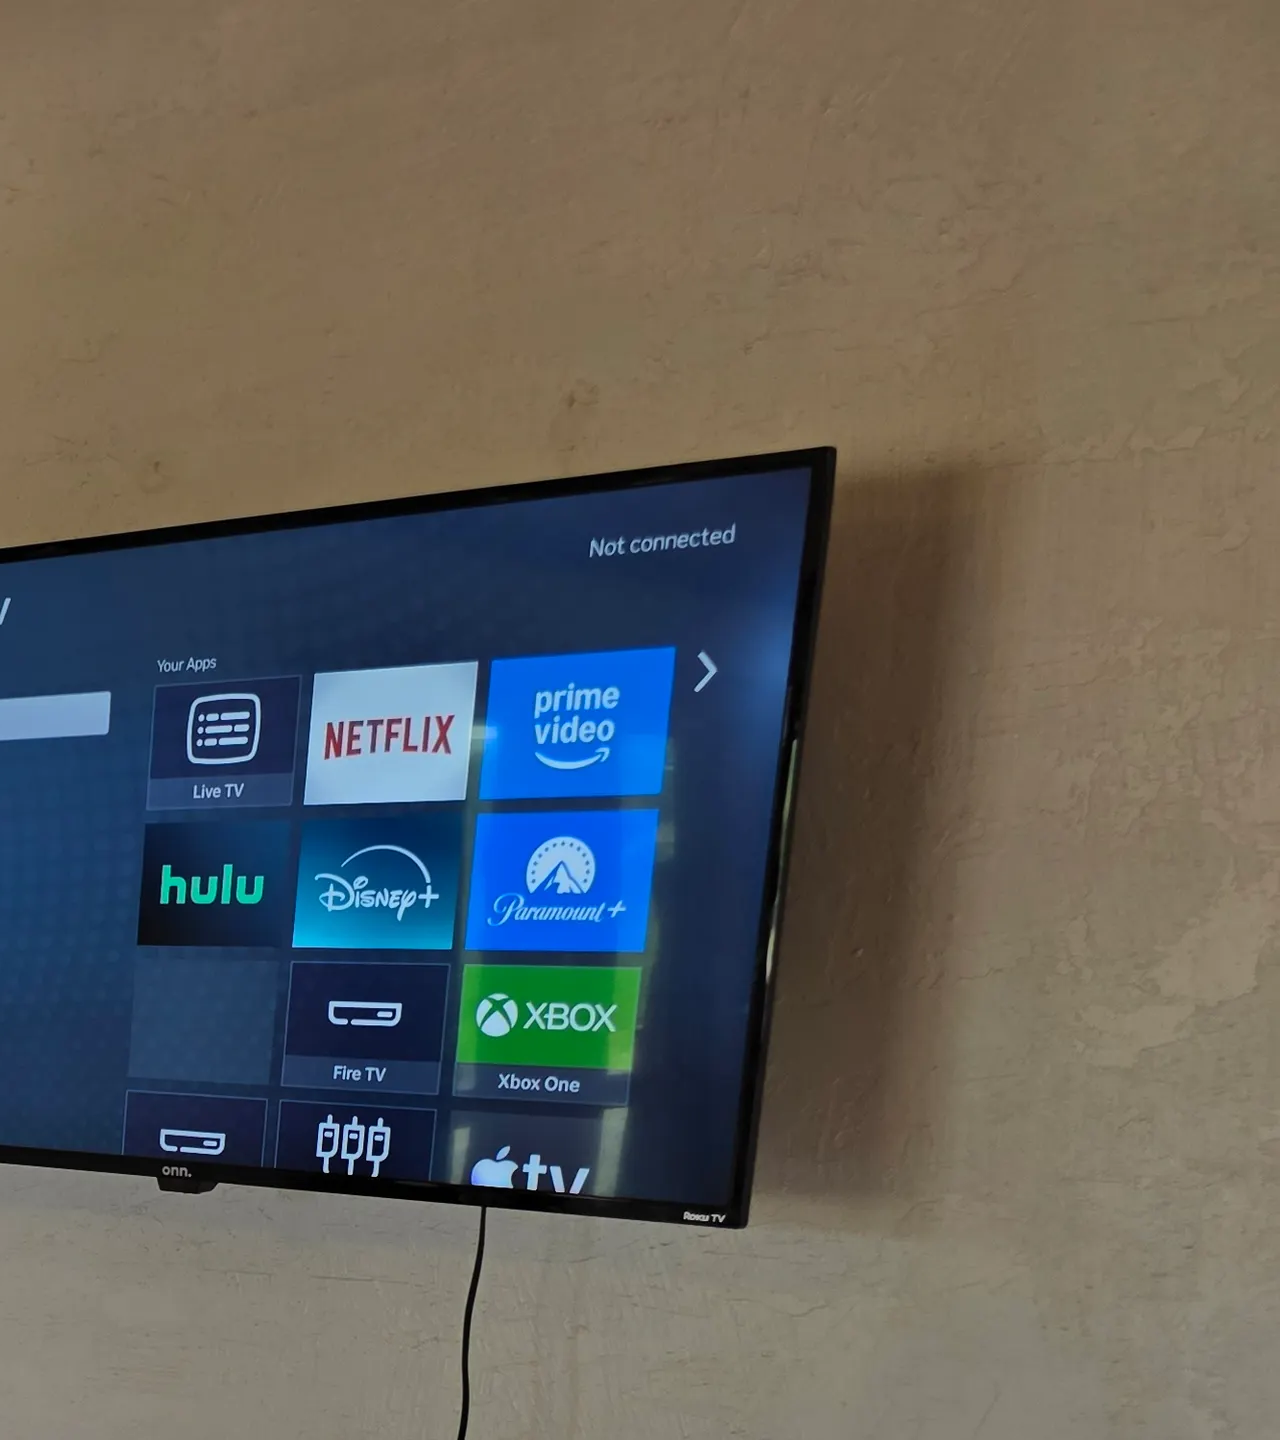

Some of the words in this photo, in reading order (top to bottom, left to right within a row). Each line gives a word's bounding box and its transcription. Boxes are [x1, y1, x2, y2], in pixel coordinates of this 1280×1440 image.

[589, 537, 626, 558] Not
[629, 523, 737, 554] connected
[157, 658, 185, 673] Your
[186, 656, 217, 672] Apps
[534, 682, 620, 719] prime
[323, 714, 456, 761] NETFLIX
[534, 715, 615, 745] video
[192, 784, 222, 800] Live
[224, 782, 245, 799] TV
[159, 864, 265, 905] hulu
[486, 892, 628, 927] Paramount+
[522, 1001, 619, 1033] XBOX
[333, 1064, 362, 1081] Fire
[364, 1066, 388, 1083] TV
[497, 1073, 541, 1092] Xbox
[544, 1075, 581, 1094] One
[522, 1153, 591, 1195] tv
[710, 1213, 727, 1223] TV
